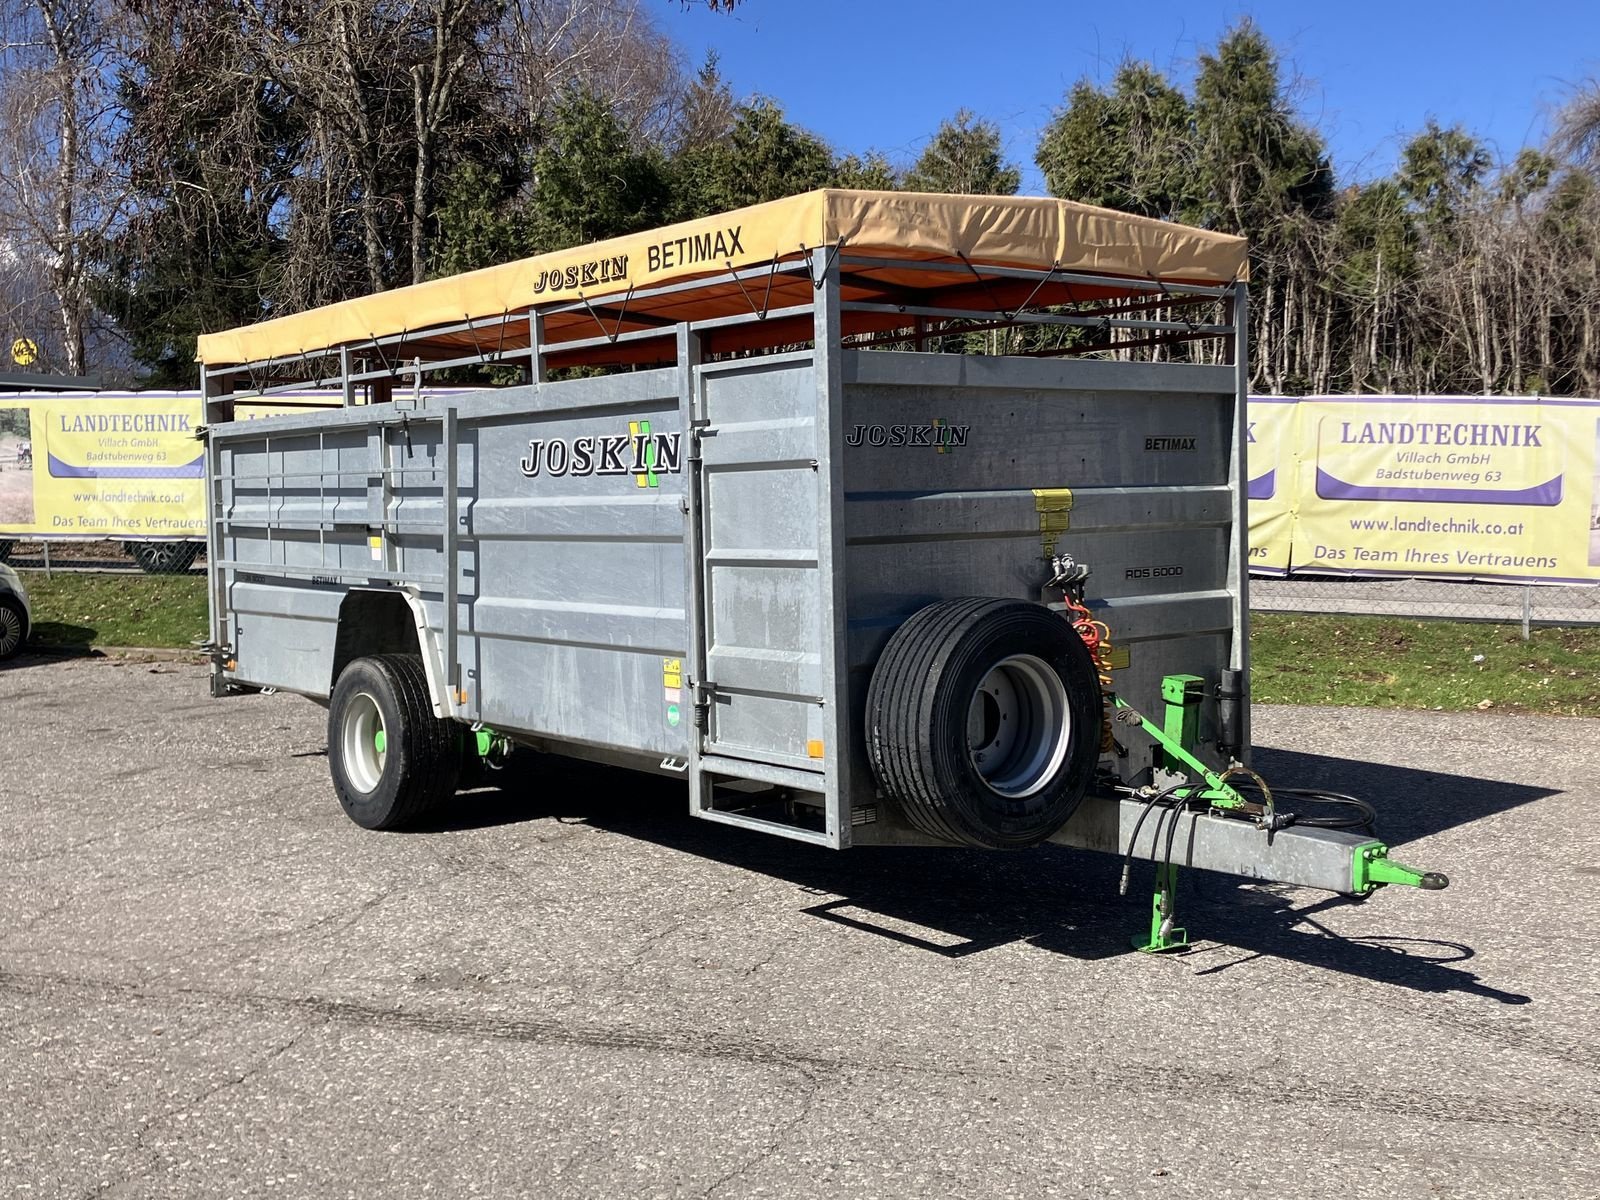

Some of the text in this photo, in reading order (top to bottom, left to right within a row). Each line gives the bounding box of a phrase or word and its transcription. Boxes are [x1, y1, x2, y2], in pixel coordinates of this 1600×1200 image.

[533, 225, 745, 293] JOSKIN BETIMAX
[60, 414, 191, 432] LANDTECHNIK
[98, 438, 159, 447] Villach GmbH
[845, 424, 970, 447] JOSKIN
[1340, 422, 1542, 447] LANDTECHNIK
[1145, 438, 1197, 450] BETIMAX
[86, 452, 167, 462] Badstubenweg 63
[520, 431, 681, 477] JOSKIN
[1396, 452, 1491, 465] Villach GmbH
[1375, 468, 1501, 484] Badstubenweg 63
[73, 490, 185, 503] www.landtechnik.co.at
[53, 515, 73, 526] Das
[77, 516, 108, 527] Team
[112, 516, 141, 527] Ihres
[1350, 516, 1523, 535] www.landtechnik.co.at
[1314, 545, 1557, 568] Das Team Ihres Vertrauens
[1125, 566, 1183, 579] RDS 6000
